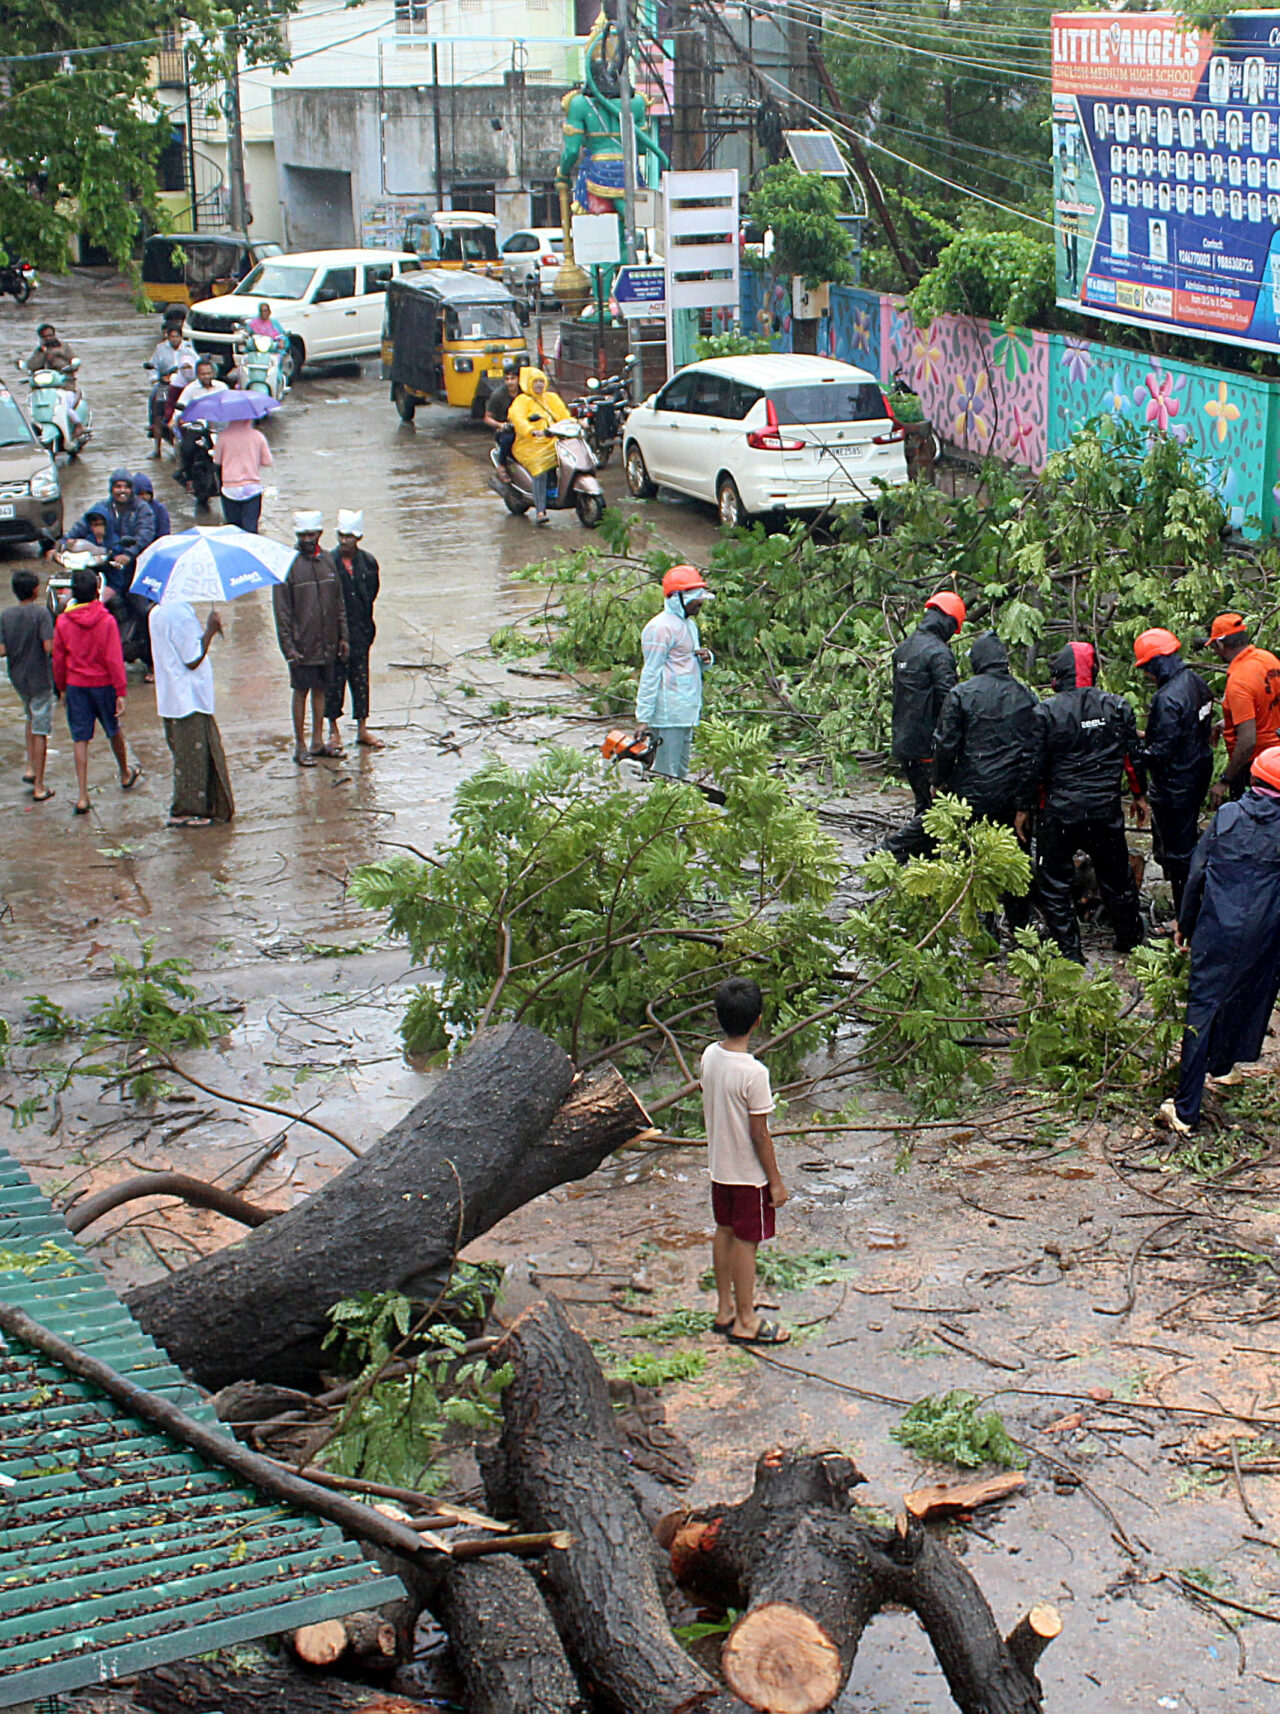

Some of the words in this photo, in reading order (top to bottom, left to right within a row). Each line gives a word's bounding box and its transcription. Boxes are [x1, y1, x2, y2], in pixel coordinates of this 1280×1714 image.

[1053, 28, 1110, 63] LITTLE
[1119, 28, 1200, 66] ANGELS
[1054, 64, 1089, 79] ENGLISH
[1090, 66, 1128, 81] MEDIUM
[1130, 68, 1153, 82] HIGH
[1155, 68, 1195, 83] SCHOOL
[1264, 66, 1277, 87] 575
